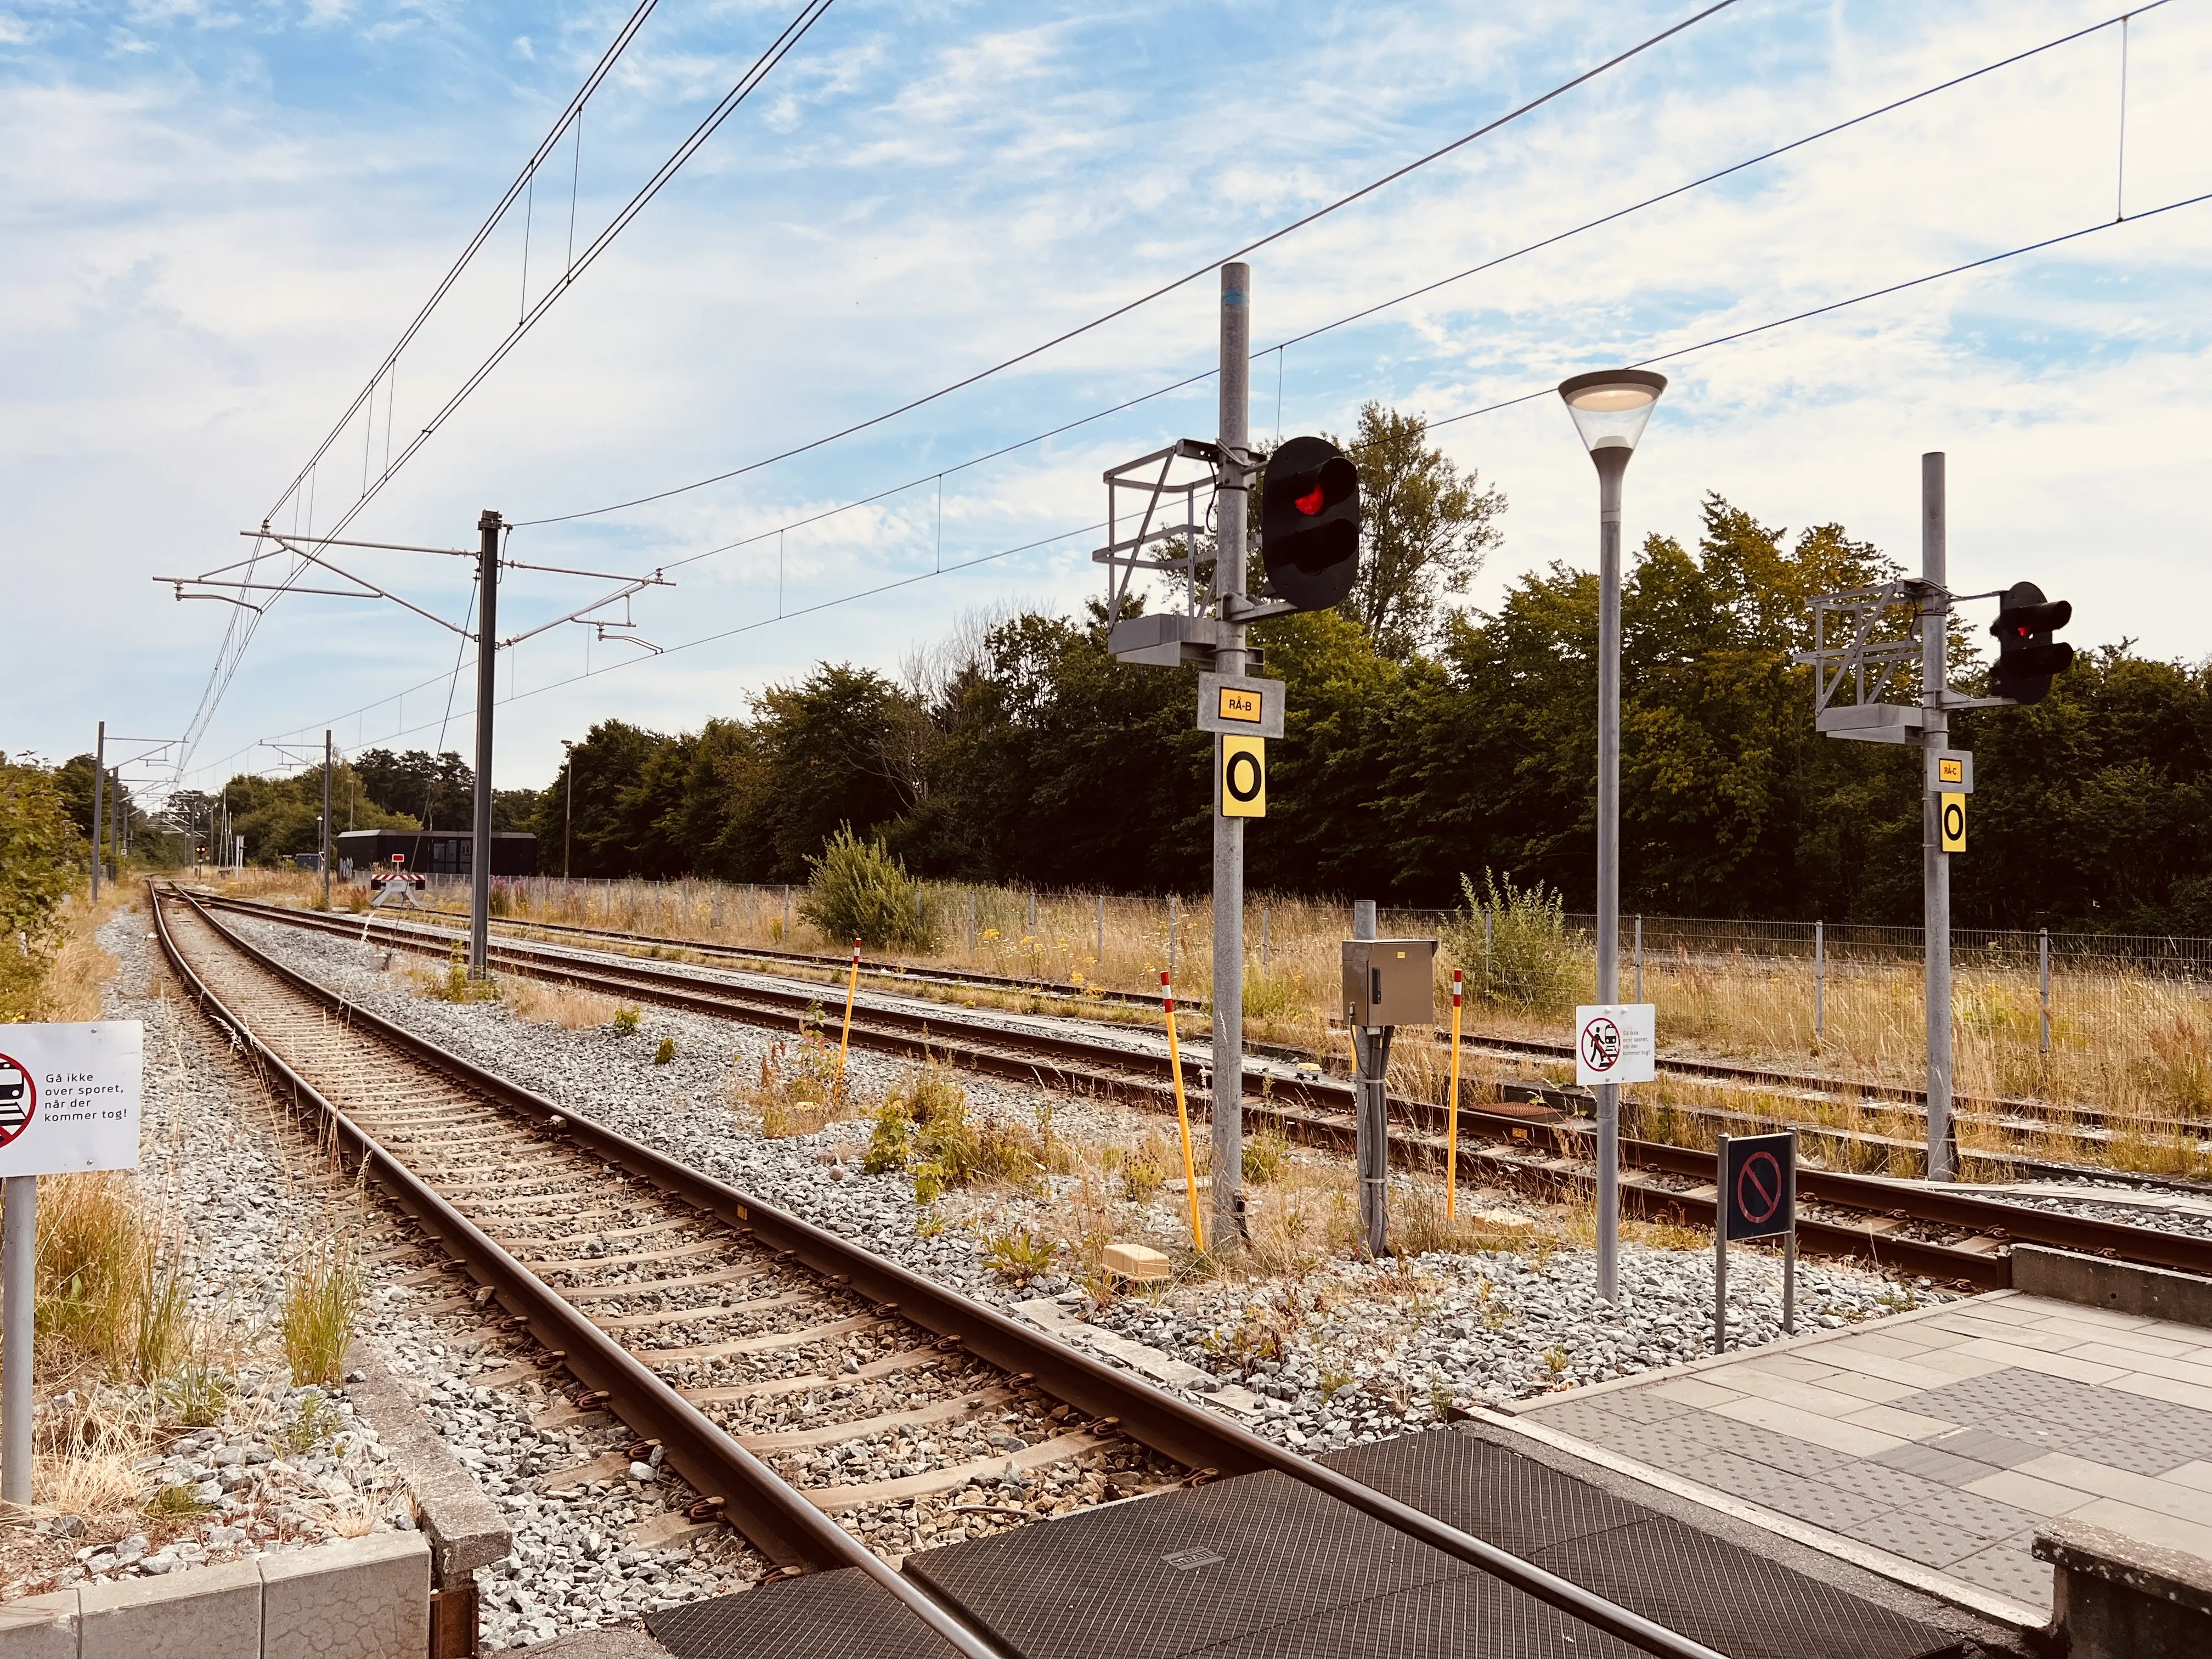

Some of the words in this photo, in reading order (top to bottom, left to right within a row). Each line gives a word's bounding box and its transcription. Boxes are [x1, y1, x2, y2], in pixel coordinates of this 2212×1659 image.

[1229, 696, 1252, 712] RÅ-B
[46, 1074, 62, 1083] Gå
[67, 1073, 93, 1082] ikke
[45, 1087, 73, 1096] over
[78, 1084, 124, 1096] sporet,
[45, 1099, 65, 1109] når
[70, 1099, 92, 1108] der
[44, 1111, 97, 1122] kommer
[102, 1109, 127, 1120] tog!
[1170, 1551, 1216, 1566] STRAIL
